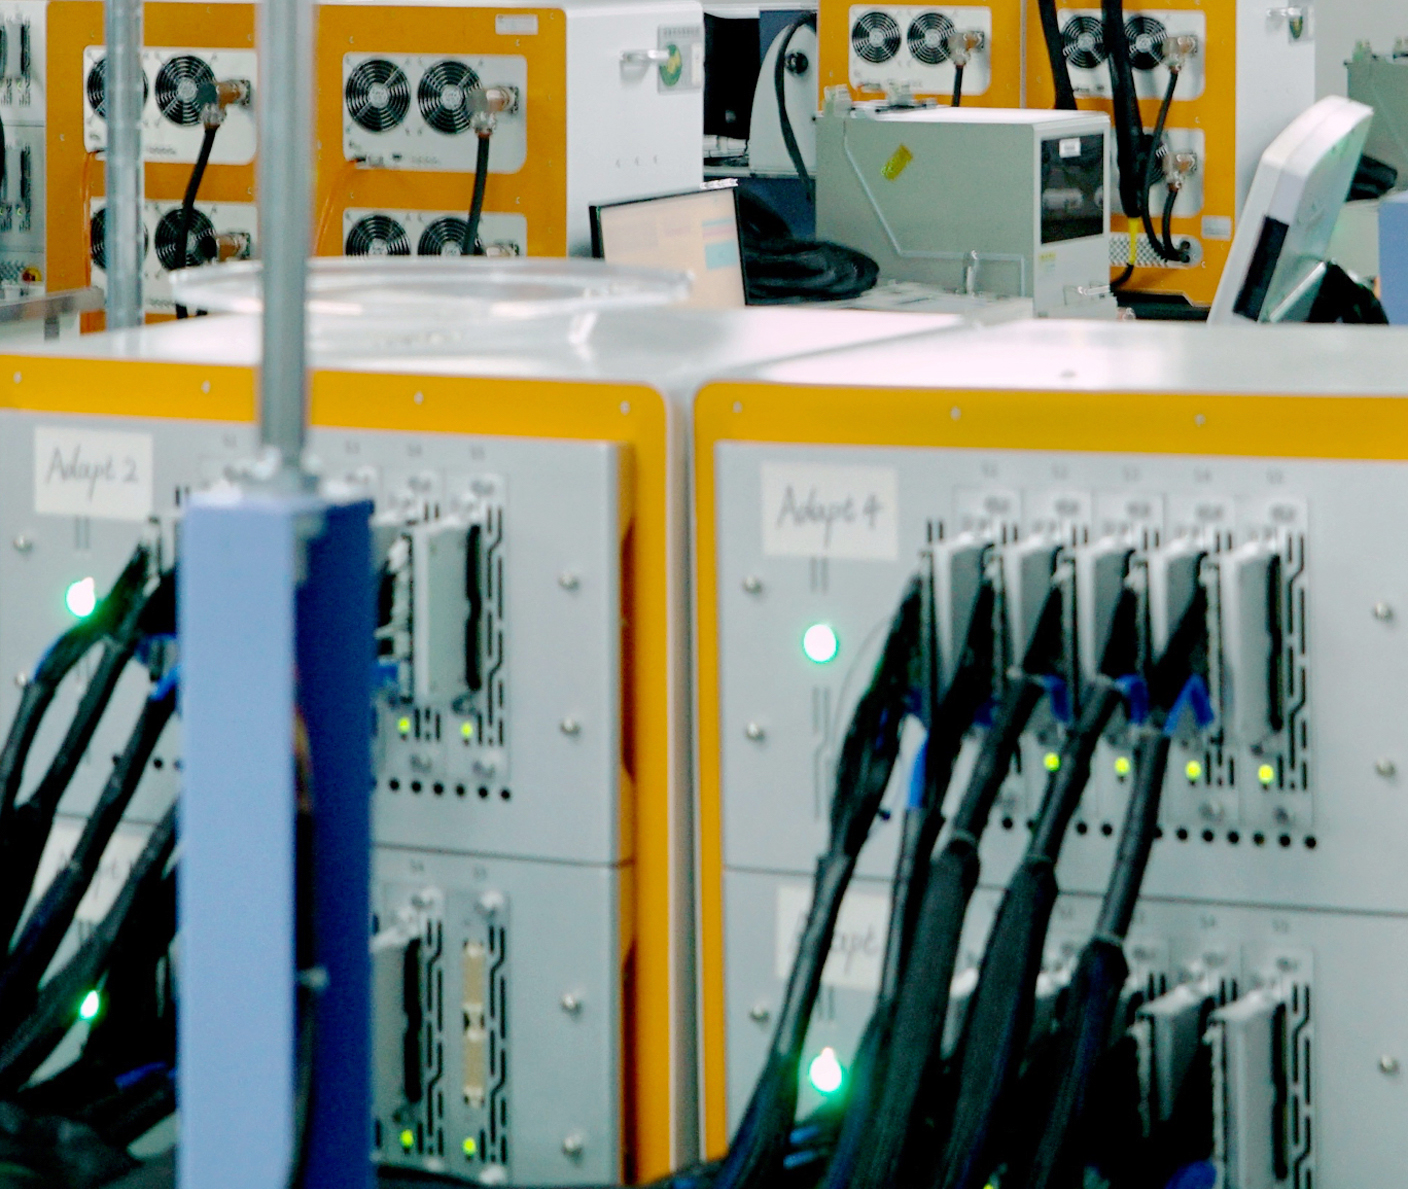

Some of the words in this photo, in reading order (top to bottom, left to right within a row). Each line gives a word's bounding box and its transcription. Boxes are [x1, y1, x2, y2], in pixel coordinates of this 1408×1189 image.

[45, 444, 115, 501] Adapt
[122, 455, 138, 484] 2
[776, 484, 854, 548] Adapt
[862, 494, 883, 530] 4
